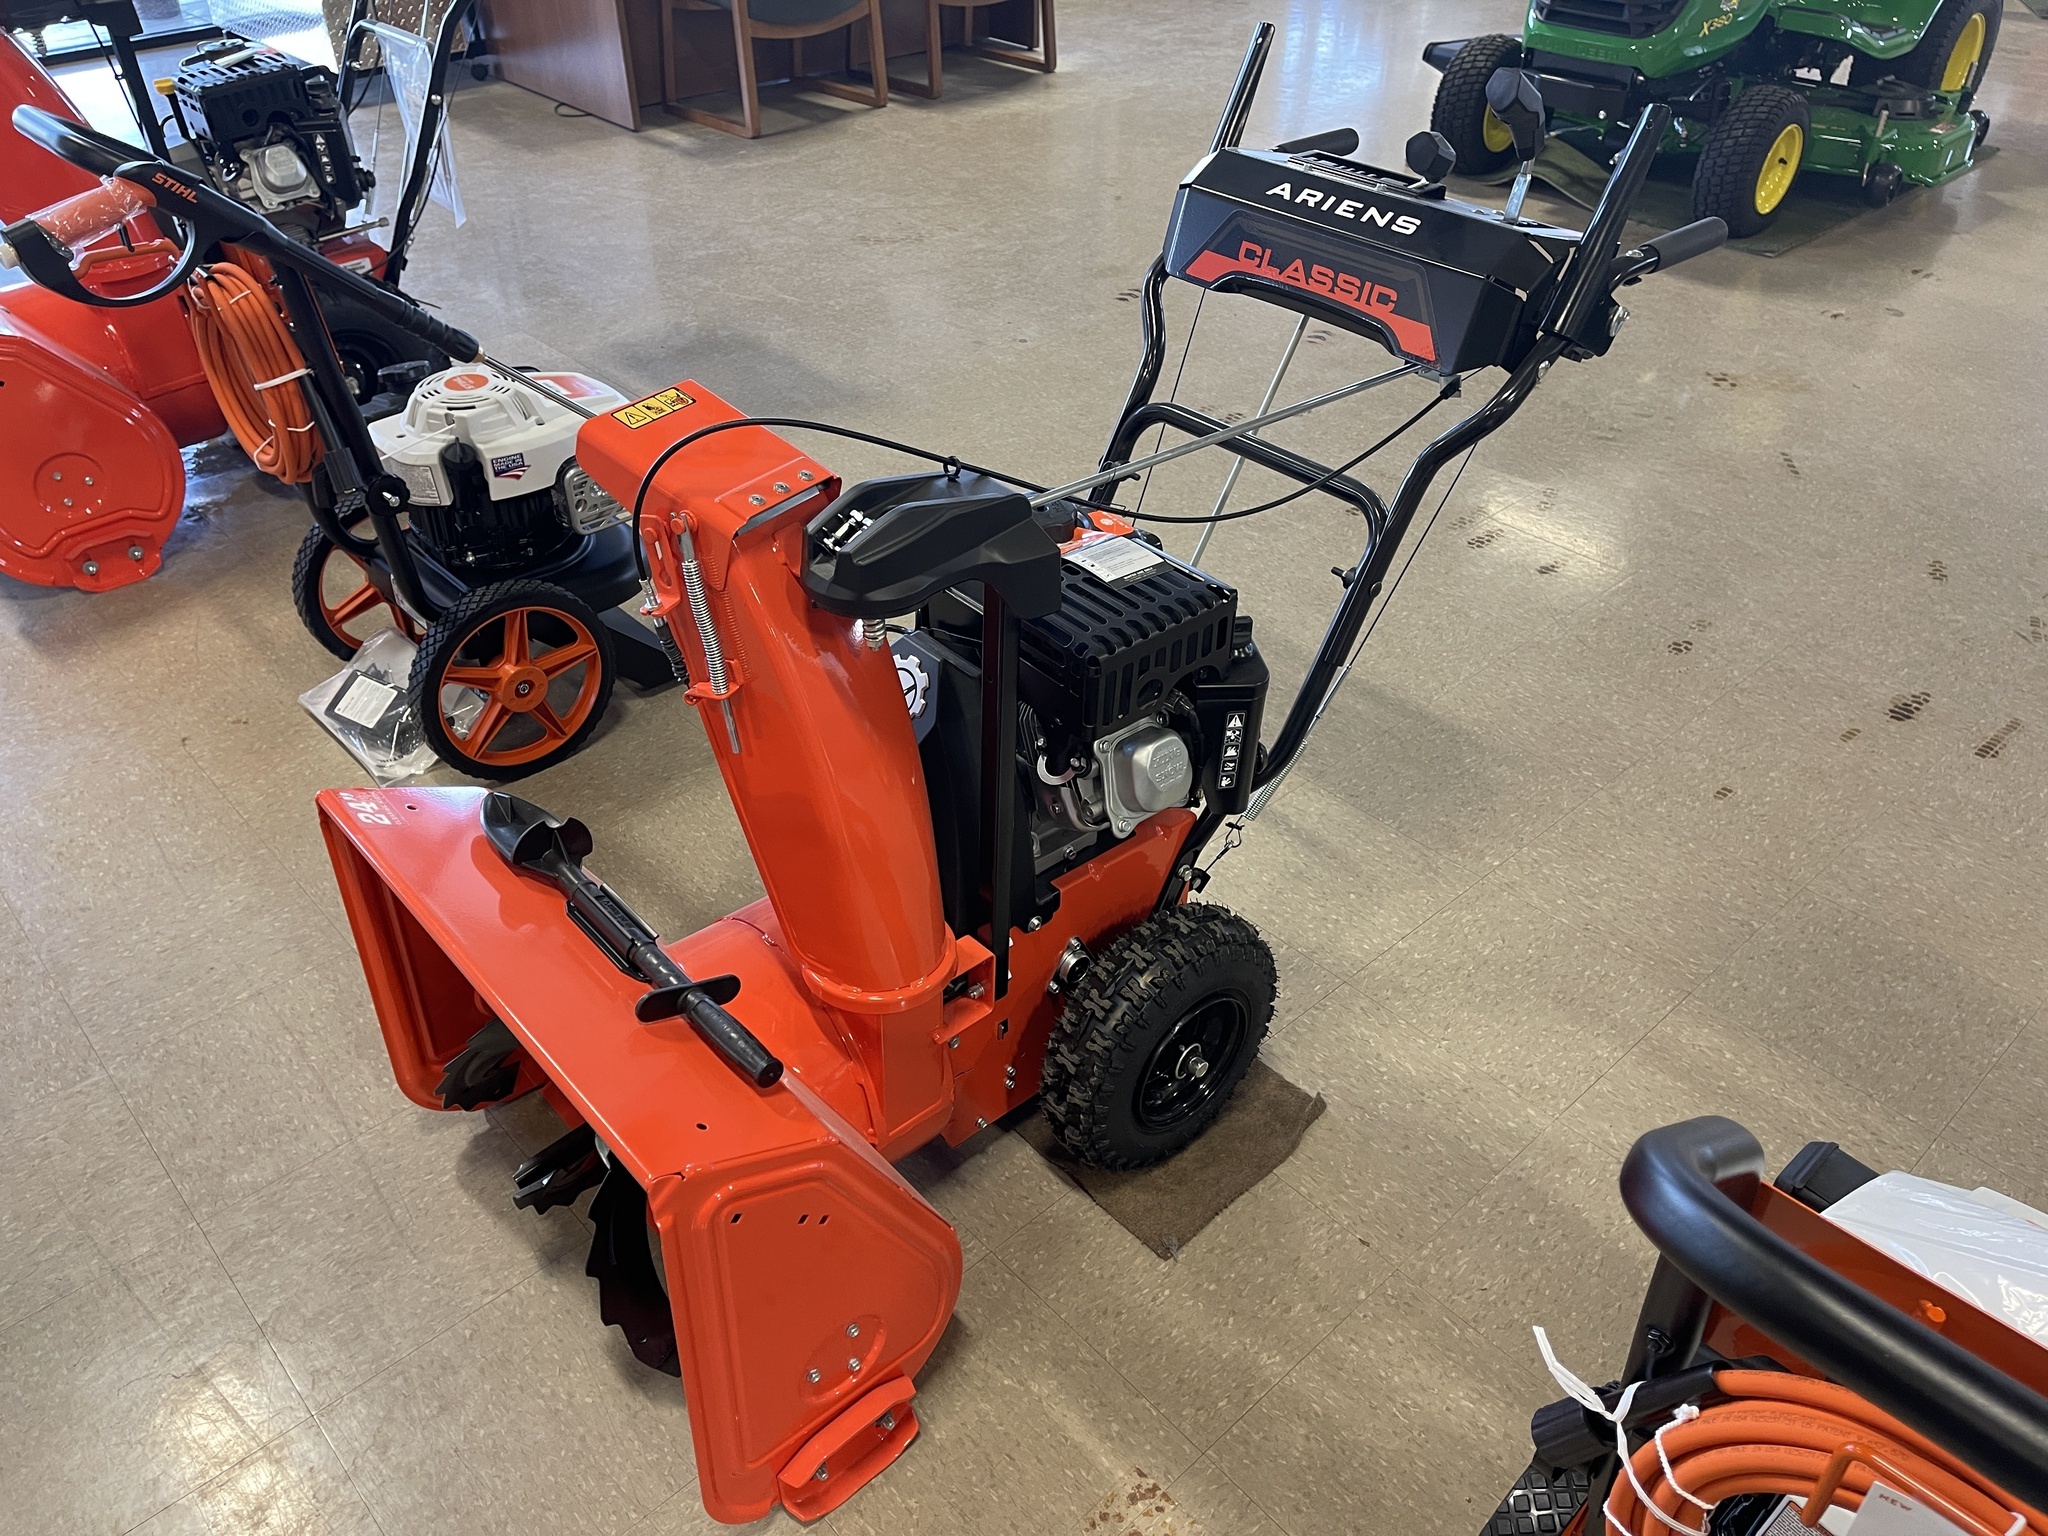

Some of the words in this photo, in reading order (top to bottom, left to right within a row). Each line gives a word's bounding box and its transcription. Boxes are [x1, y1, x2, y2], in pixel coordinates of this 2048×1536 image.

[151, 172, 198, 204] STIHL
[1265, 182, 1422, 236] ARIENS
[1238, 240, 1398, 313] CLASSIC
[492, 454, 521, 464] ENGINE
[1879, 1493, 1912, 1511] NEW
